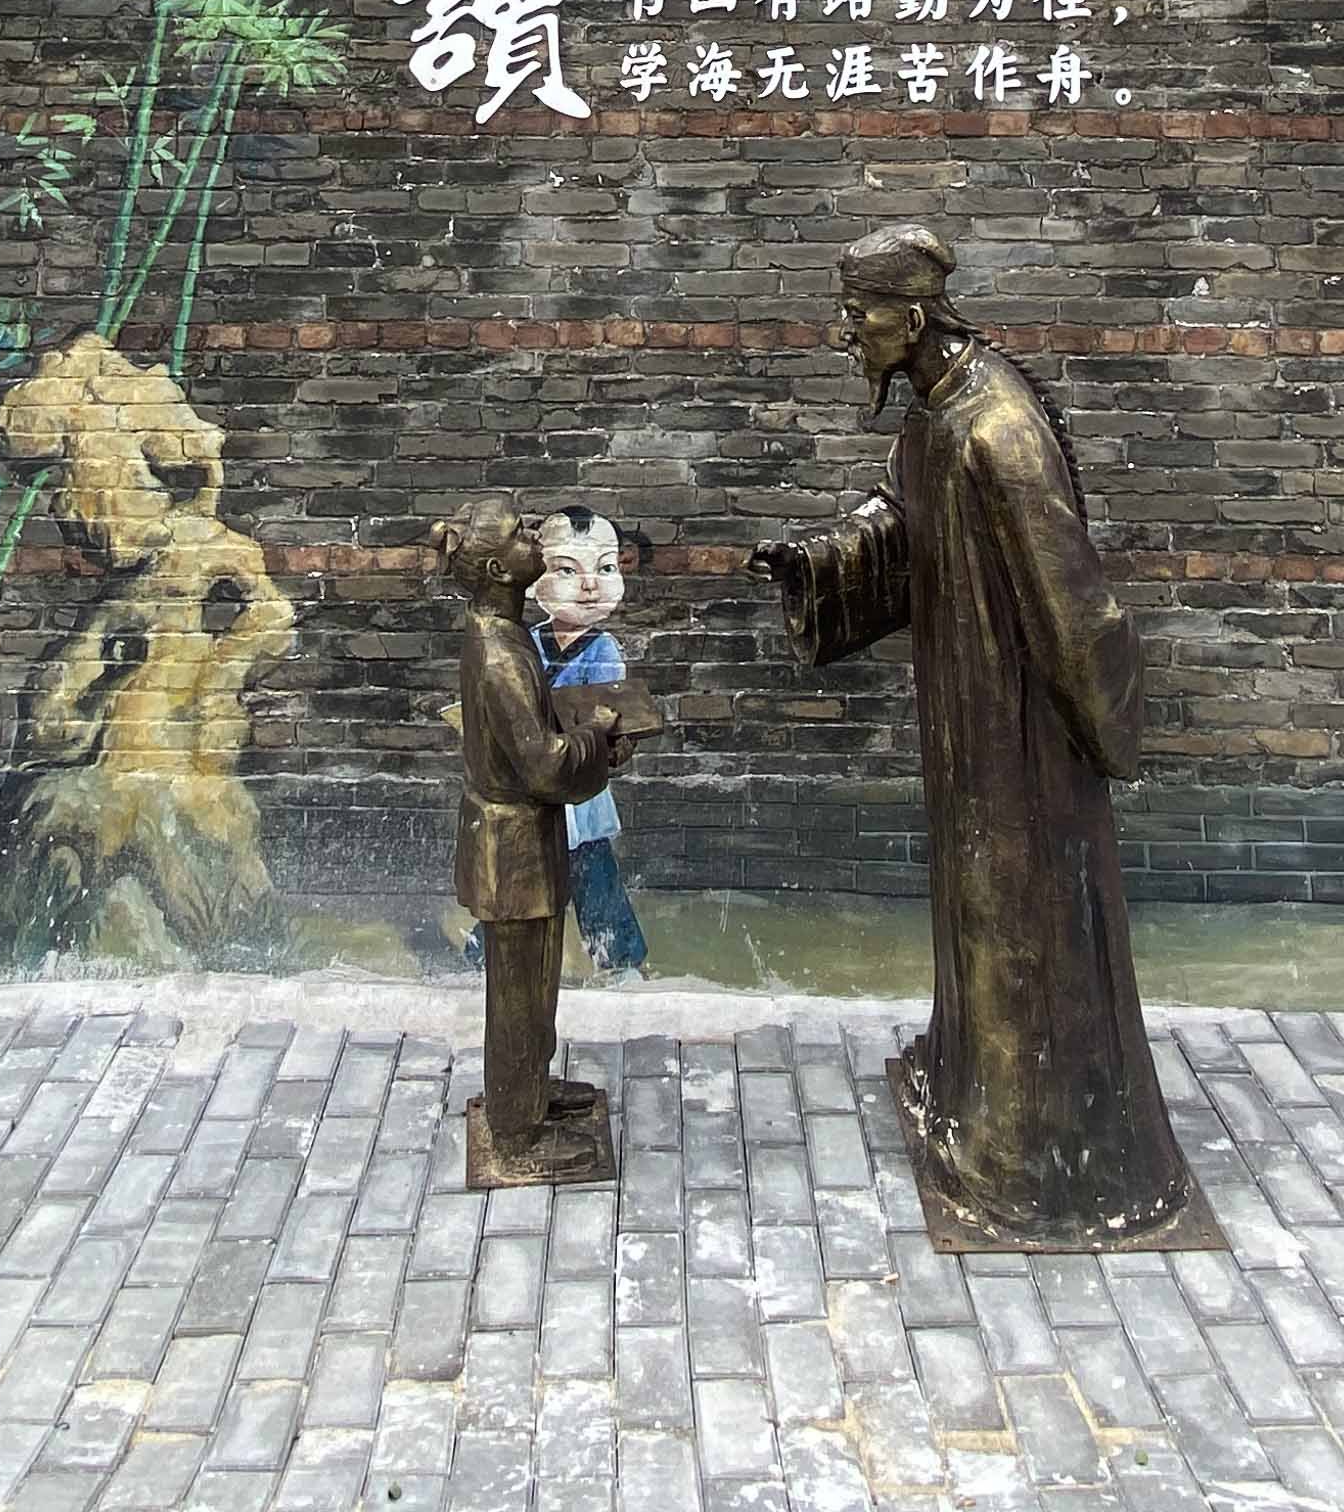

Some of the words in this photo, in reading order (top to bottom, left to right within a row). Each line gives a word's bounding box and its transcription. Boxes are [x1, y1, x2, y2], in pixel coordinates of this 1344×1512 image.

[618, 43, 1134, 106] 学海无涯苦作舟。
